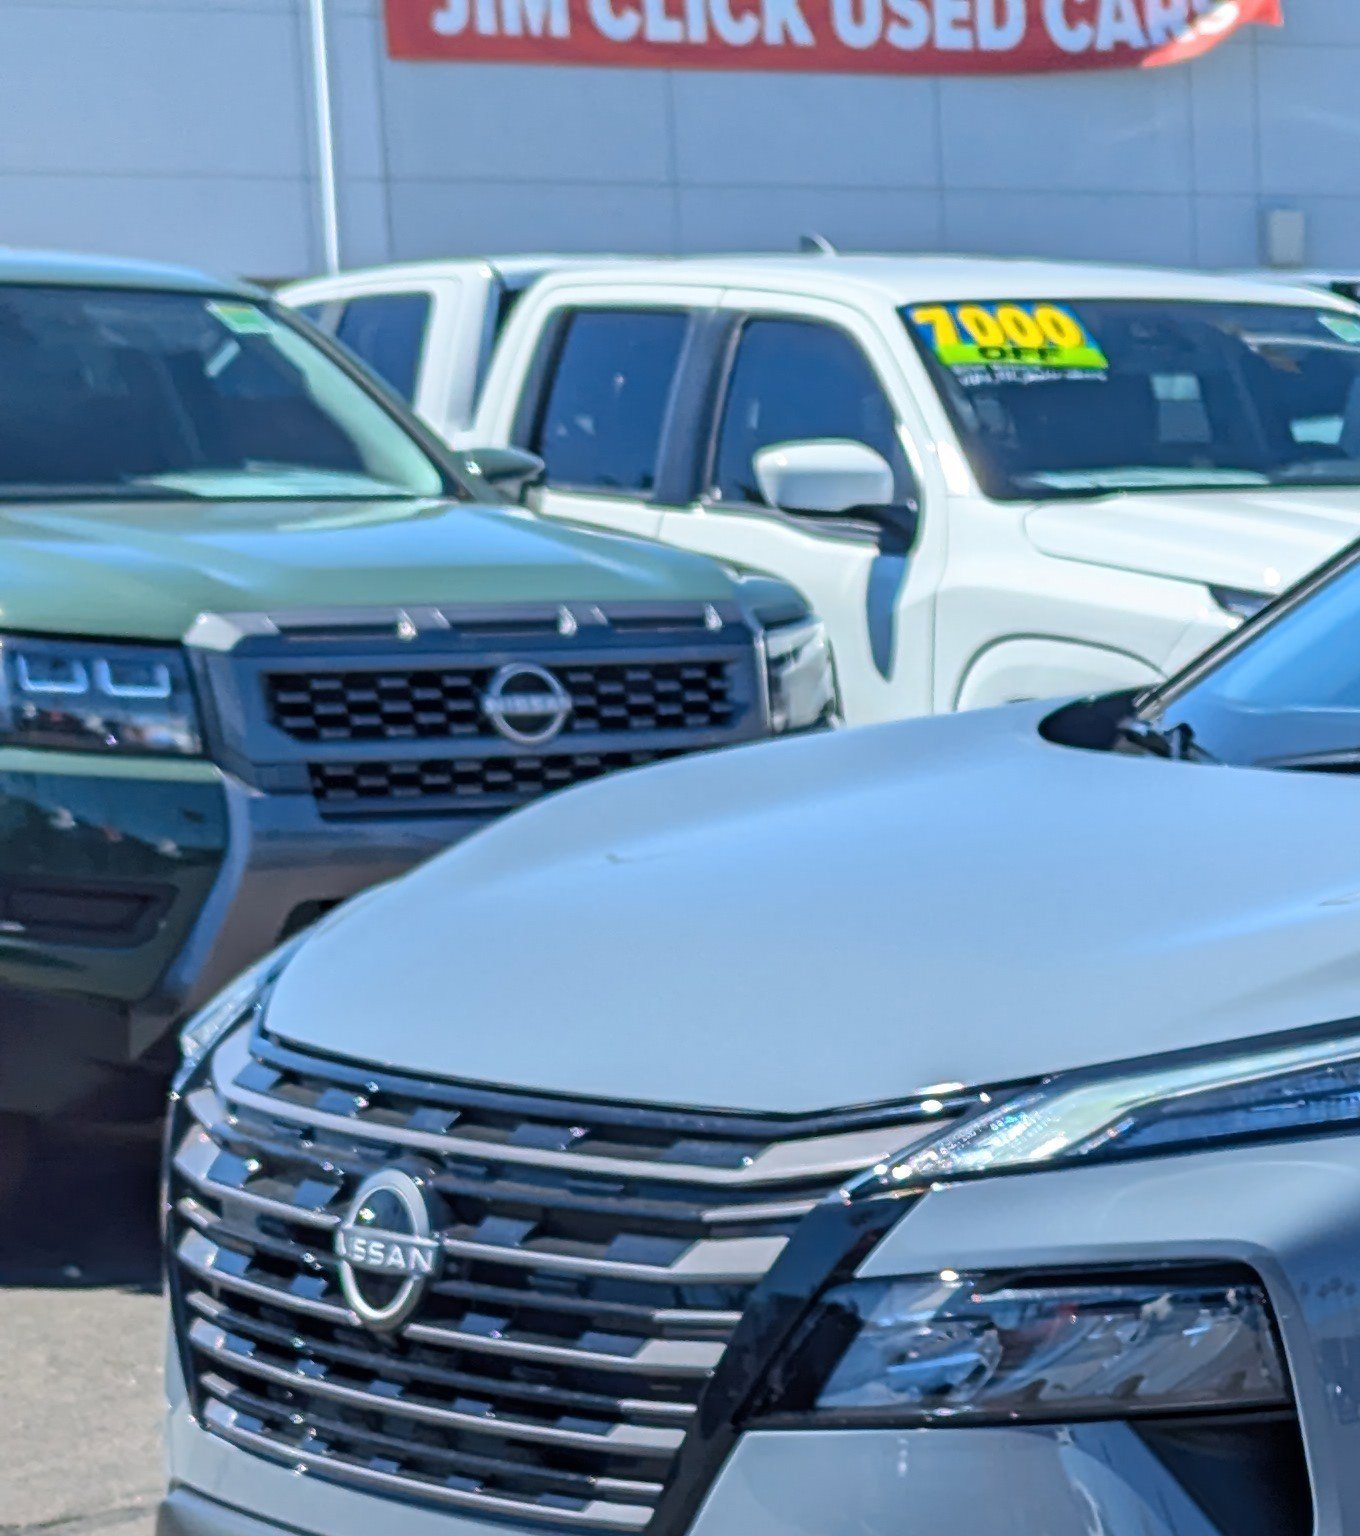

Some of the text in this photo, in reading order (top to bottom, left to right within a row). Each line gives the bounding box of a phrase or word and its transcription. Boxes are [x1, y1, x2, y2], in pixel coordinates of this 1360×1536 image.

[431, 0, 571, 38] JIM
[588, 0, 816, 47] CLICK
[833, 0, 1026, 50] USED
[911, 304, 1085, 349] 7000
[336, 1230, 433, 1272] NISSAN
